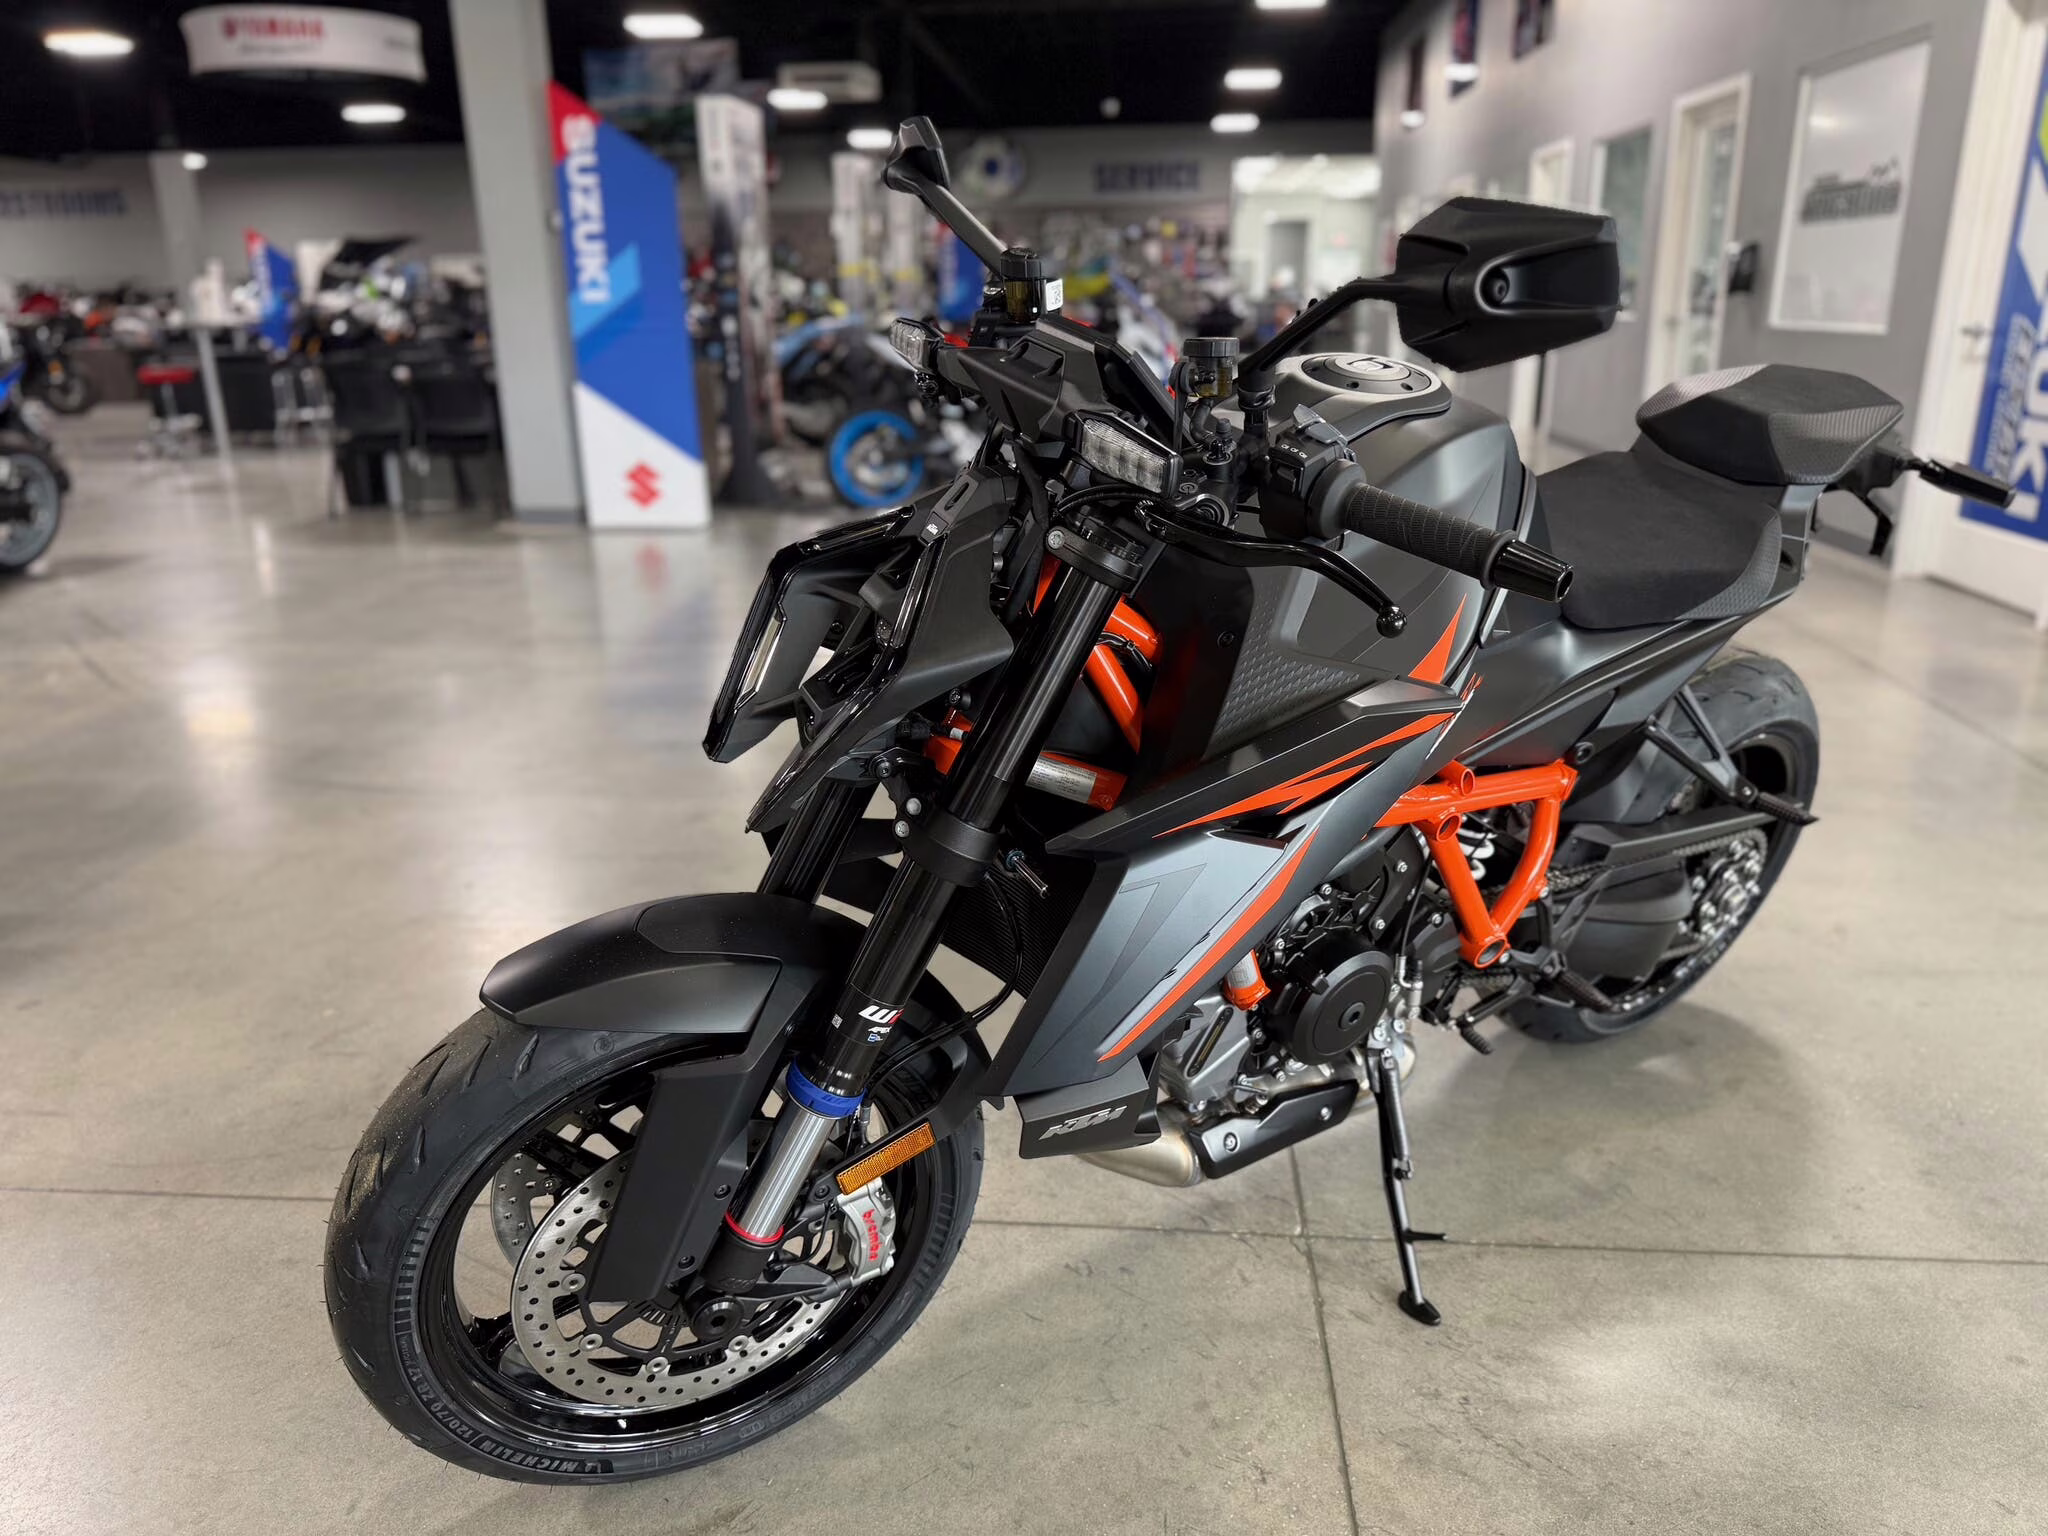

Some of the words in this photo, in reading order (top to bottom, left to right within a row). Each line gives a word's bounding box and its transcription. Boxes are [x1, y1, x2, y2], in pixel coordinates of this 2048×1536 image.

[560, 113, 612, 304] SUZUKI
[1038, 1105, 1128, 1141] KTM
[430, 1401, 475, 1440] 120/70
[480, 1437, 580, 1473] MICHELIN
